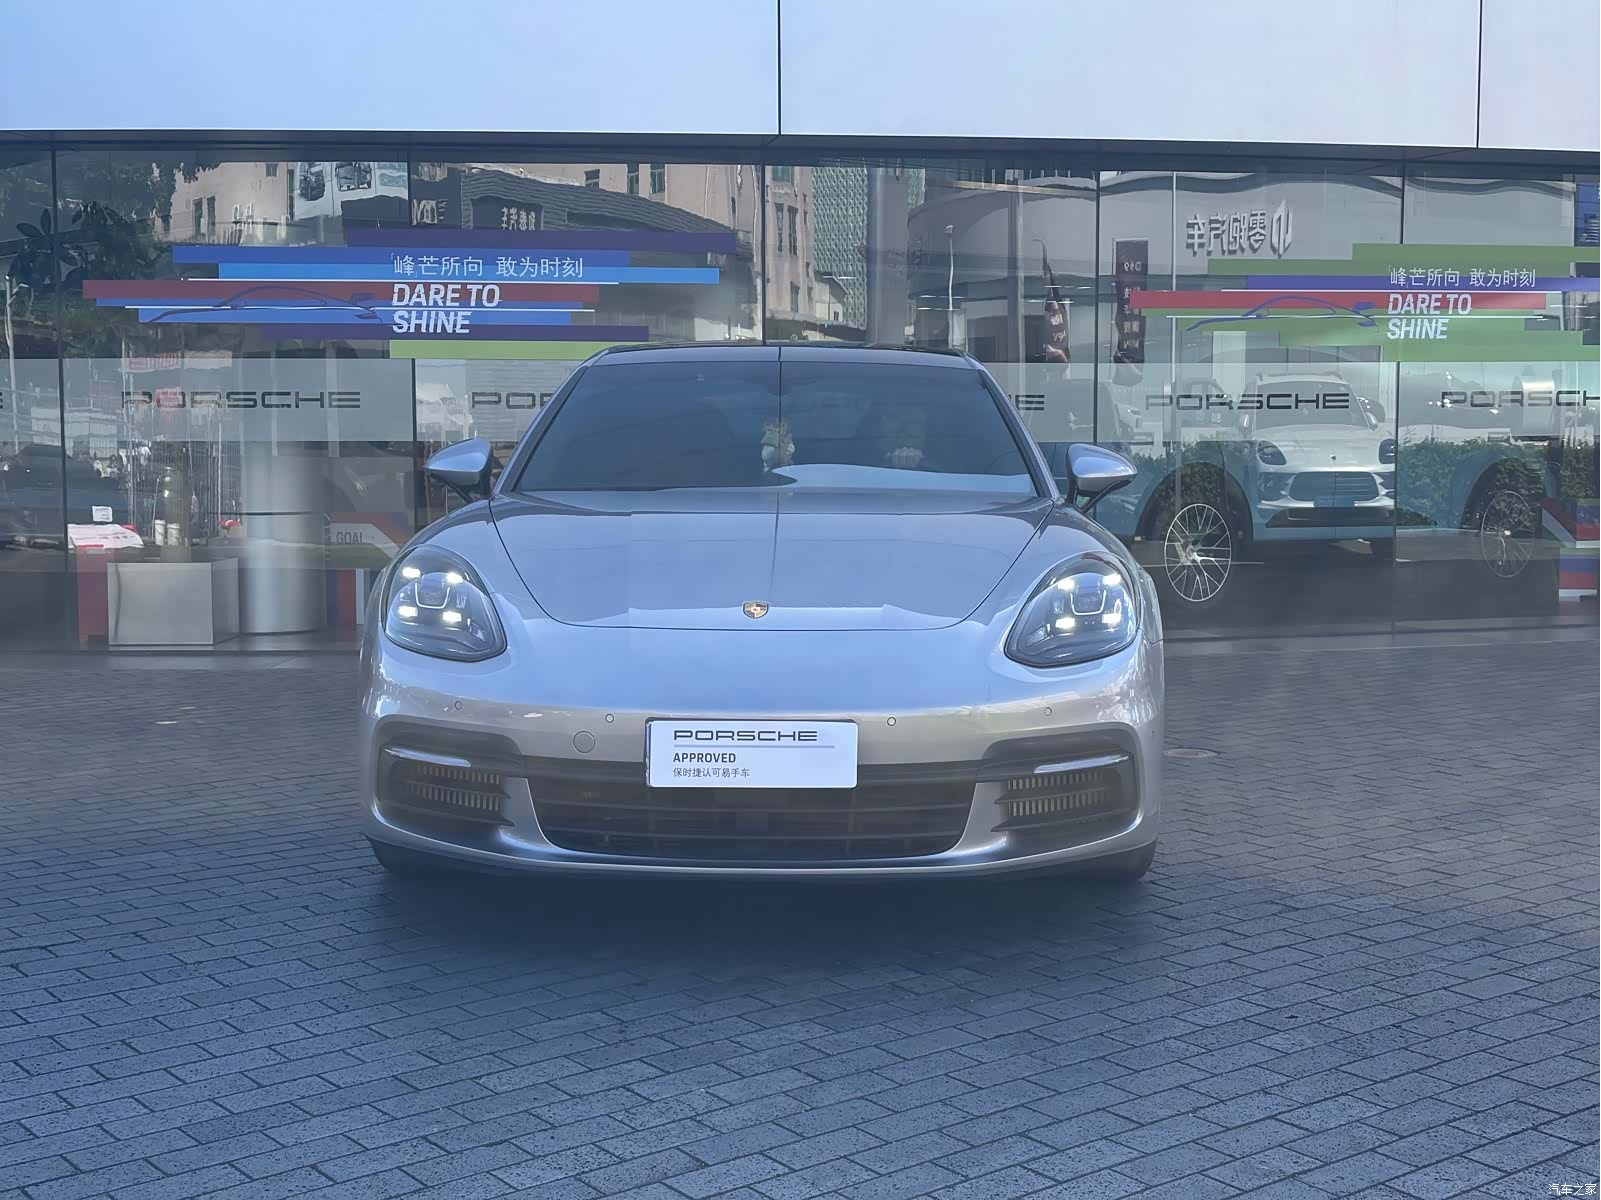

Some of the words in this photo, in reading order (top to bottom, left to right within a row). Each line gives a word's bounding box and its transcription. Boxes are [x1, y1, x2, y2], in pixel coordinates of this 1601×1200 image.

[496, 256, 583, 278] 敢为时刻
[1469, 268, 1536, 288] 敢为时刻
[392, 283, 461, 306] DARE
[467, 284, 501, 307] TO
[1388, 293, 1443, 315] DARE
[1447, 293, 1472, 315] TO
[392, 310, 472, 334] SHINE
[1387, 318, 1449, 340] SHINE
[121, 390, 361, 409] PORSCHE
[1145, 392, 1350, 410] PORSCHE
[673, 730, 818, 742] PORSCHE
[673, 752, 736, 763] APPROVED
[673, 767, 750, 778] 保时捷认可易手车
